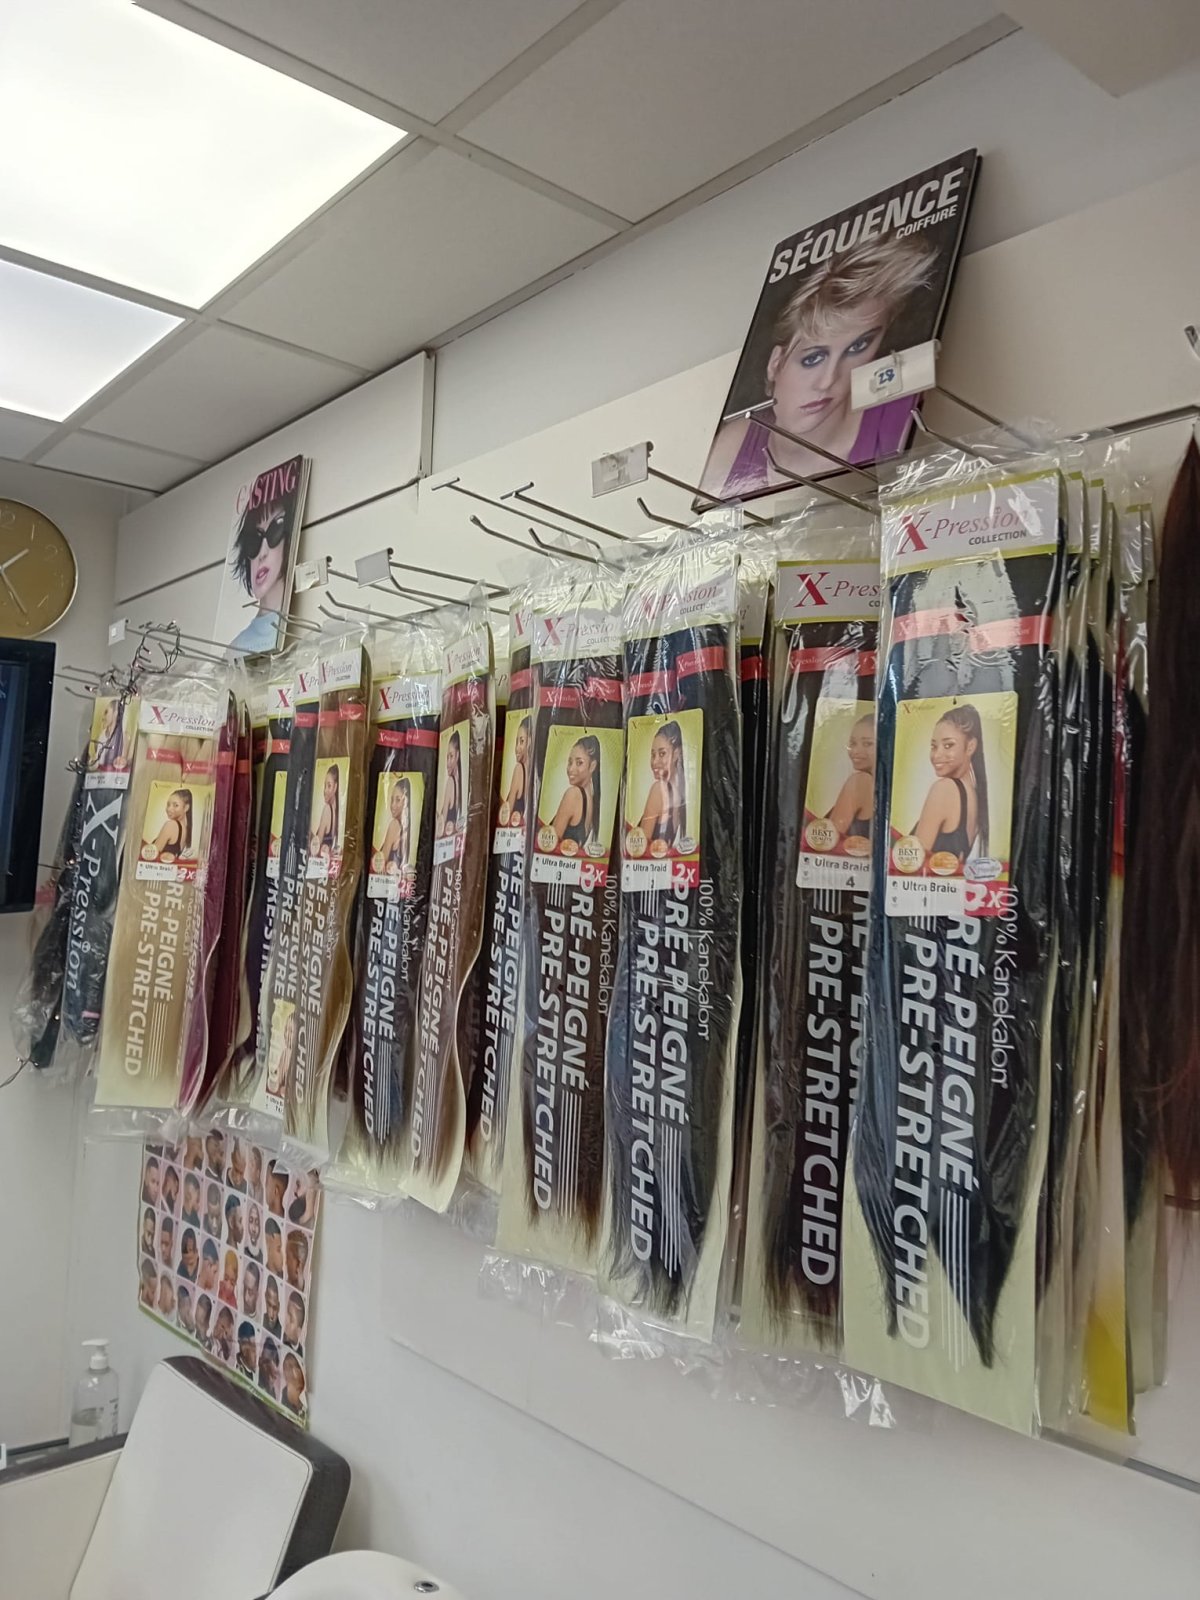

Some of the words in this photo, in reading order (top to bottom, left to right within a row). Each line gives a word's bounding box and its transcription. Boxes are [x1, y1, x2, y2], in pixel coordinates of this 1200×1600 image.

[769, 166, 965, 284] SÉQUENCE
[895, 204, 958, 240] COIFFURE
[794, 572, 880, 608] X-Pres
[968, 529, 1027, 546] COLLECTION
[147, 705, 216, 727] X-Pression
[66, 791, 124, 990] X-Pression
[603, 874, 618, 916] 100%
[632, 864, 649, 872] Ultra
[675, 863, 696, 883] 2x
[698, 878, 714, 929] 100%
[815, 858, 840, 869] Ultra
[842, 861, 870, 872] Braid
[845, 876, 856, 888] 4
[898, 848, 919, 856] BEST
[902, 881, 928, 891] Ultra
[153, 880, 185, 1002] RÉ-PEIGNÉ
[399, 903, 415, 981] Kanekalon
[428, 867, 454, 1054] PRÉ-PEIGNÉ
[597, 918, 617, 1016] Kanekalon
[992, 883, 1018, 951] 100%
[125, 890, 161, 1076] PRE-STRETCHED
[363, 899, 385, 1135] PRE-STRETCHED
[409, 903, 439, 1158] PRE-STRETCHED
[479, 871, 509, 1142] PRE-STRETCHED
[660, 876, 690, 1125] PRÉ-PEIGNÉ
[697, 929, 714, 1041] Kanekalon
[990, 954, 1017, 1084] Kanekalon
[533, 909, 566, 1210] PRE-STRETCHED
[631, 918, 657, 1261] PRE-STRETCHED
[801, 914, 844, 1286] PRE-STRETCHED
[893, 933, 938, 1350] PRE-STRETCHED
